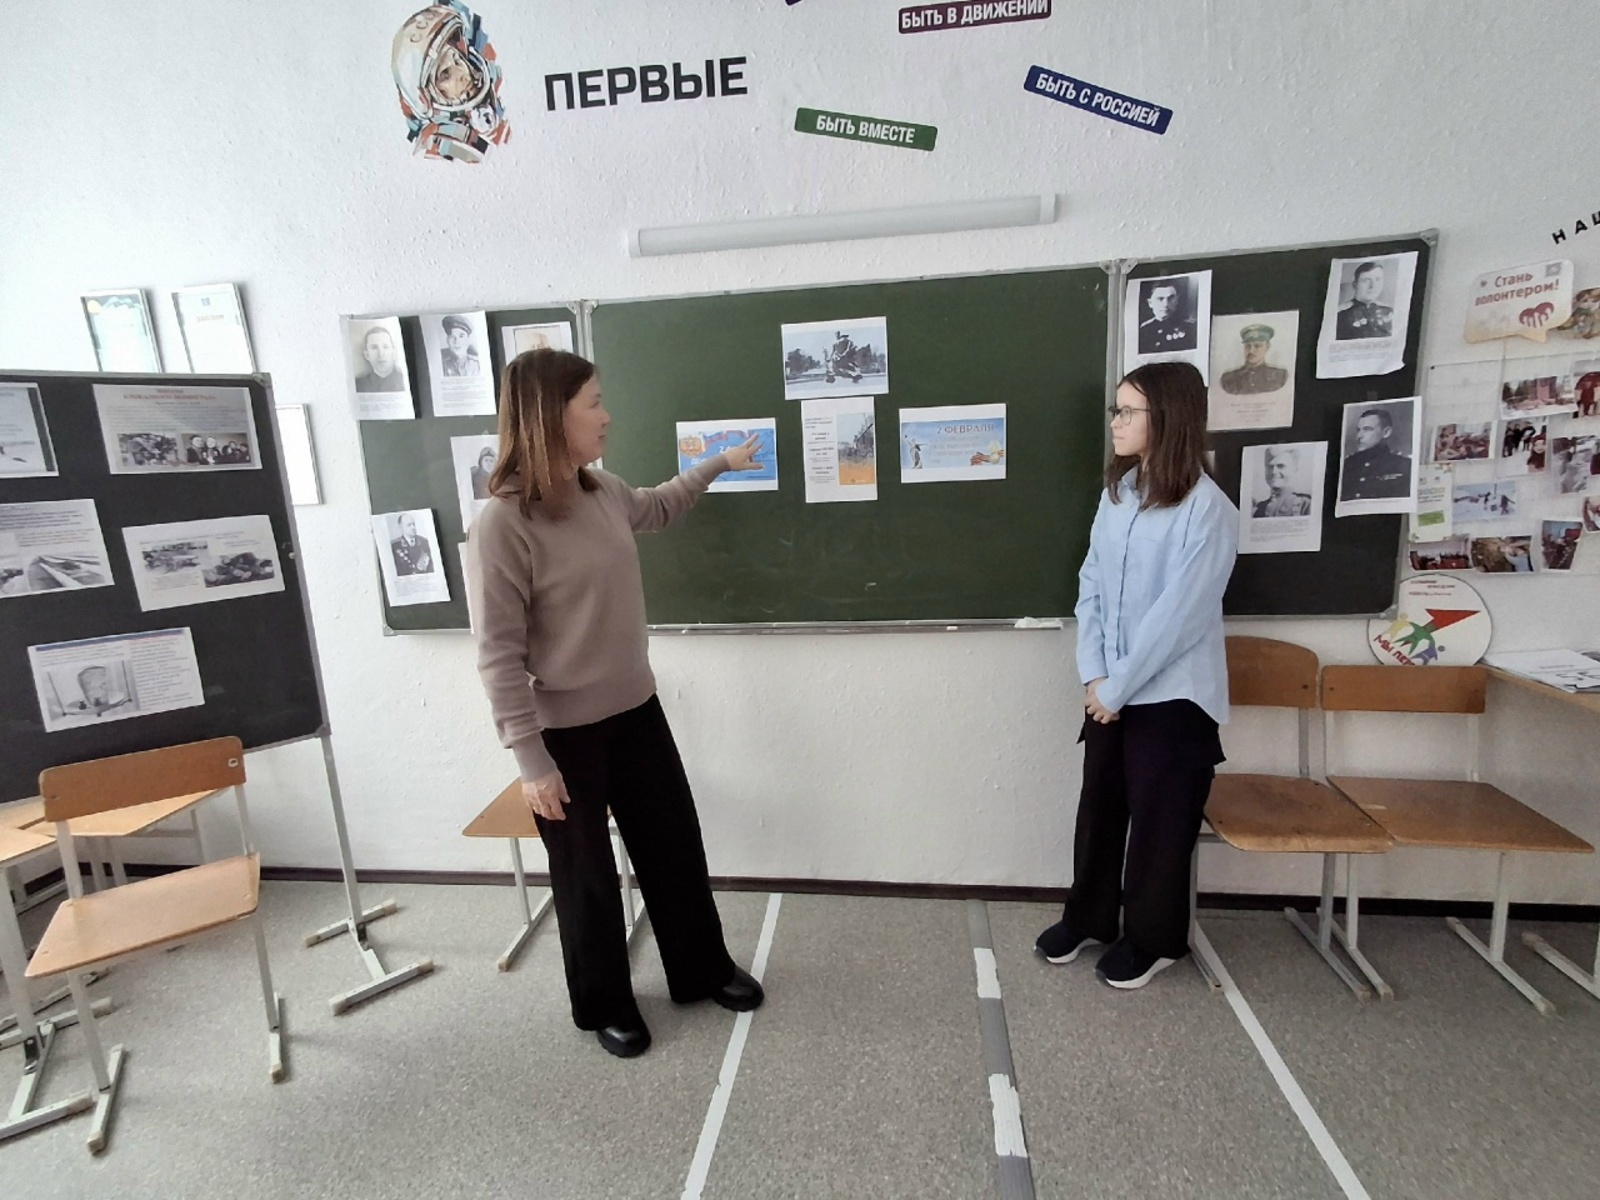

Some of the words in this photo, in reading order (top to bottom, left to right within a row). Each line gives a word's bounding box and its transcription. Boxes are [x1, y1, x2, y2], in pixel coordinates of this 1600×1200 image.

[901, 10, 943, 29] БЫТЬ
[947, 8, 957, 24] В
[960, 0, 1048, 26] ДВИЖЕНИИ
[544, 56, 748, 111] ПЕРВЫЕ
[1035, 73, 1077, 100] БЫТЬ
[1079, 88, 1091, 104] С
[1091, 91, 1160, 127] РОССИЕЙ
[816, 114, 856, 135] БЫТЬ
[858, 121, 916, 144] ВМЕСТЕ
[1494, 272, 1534, 288] Стань
